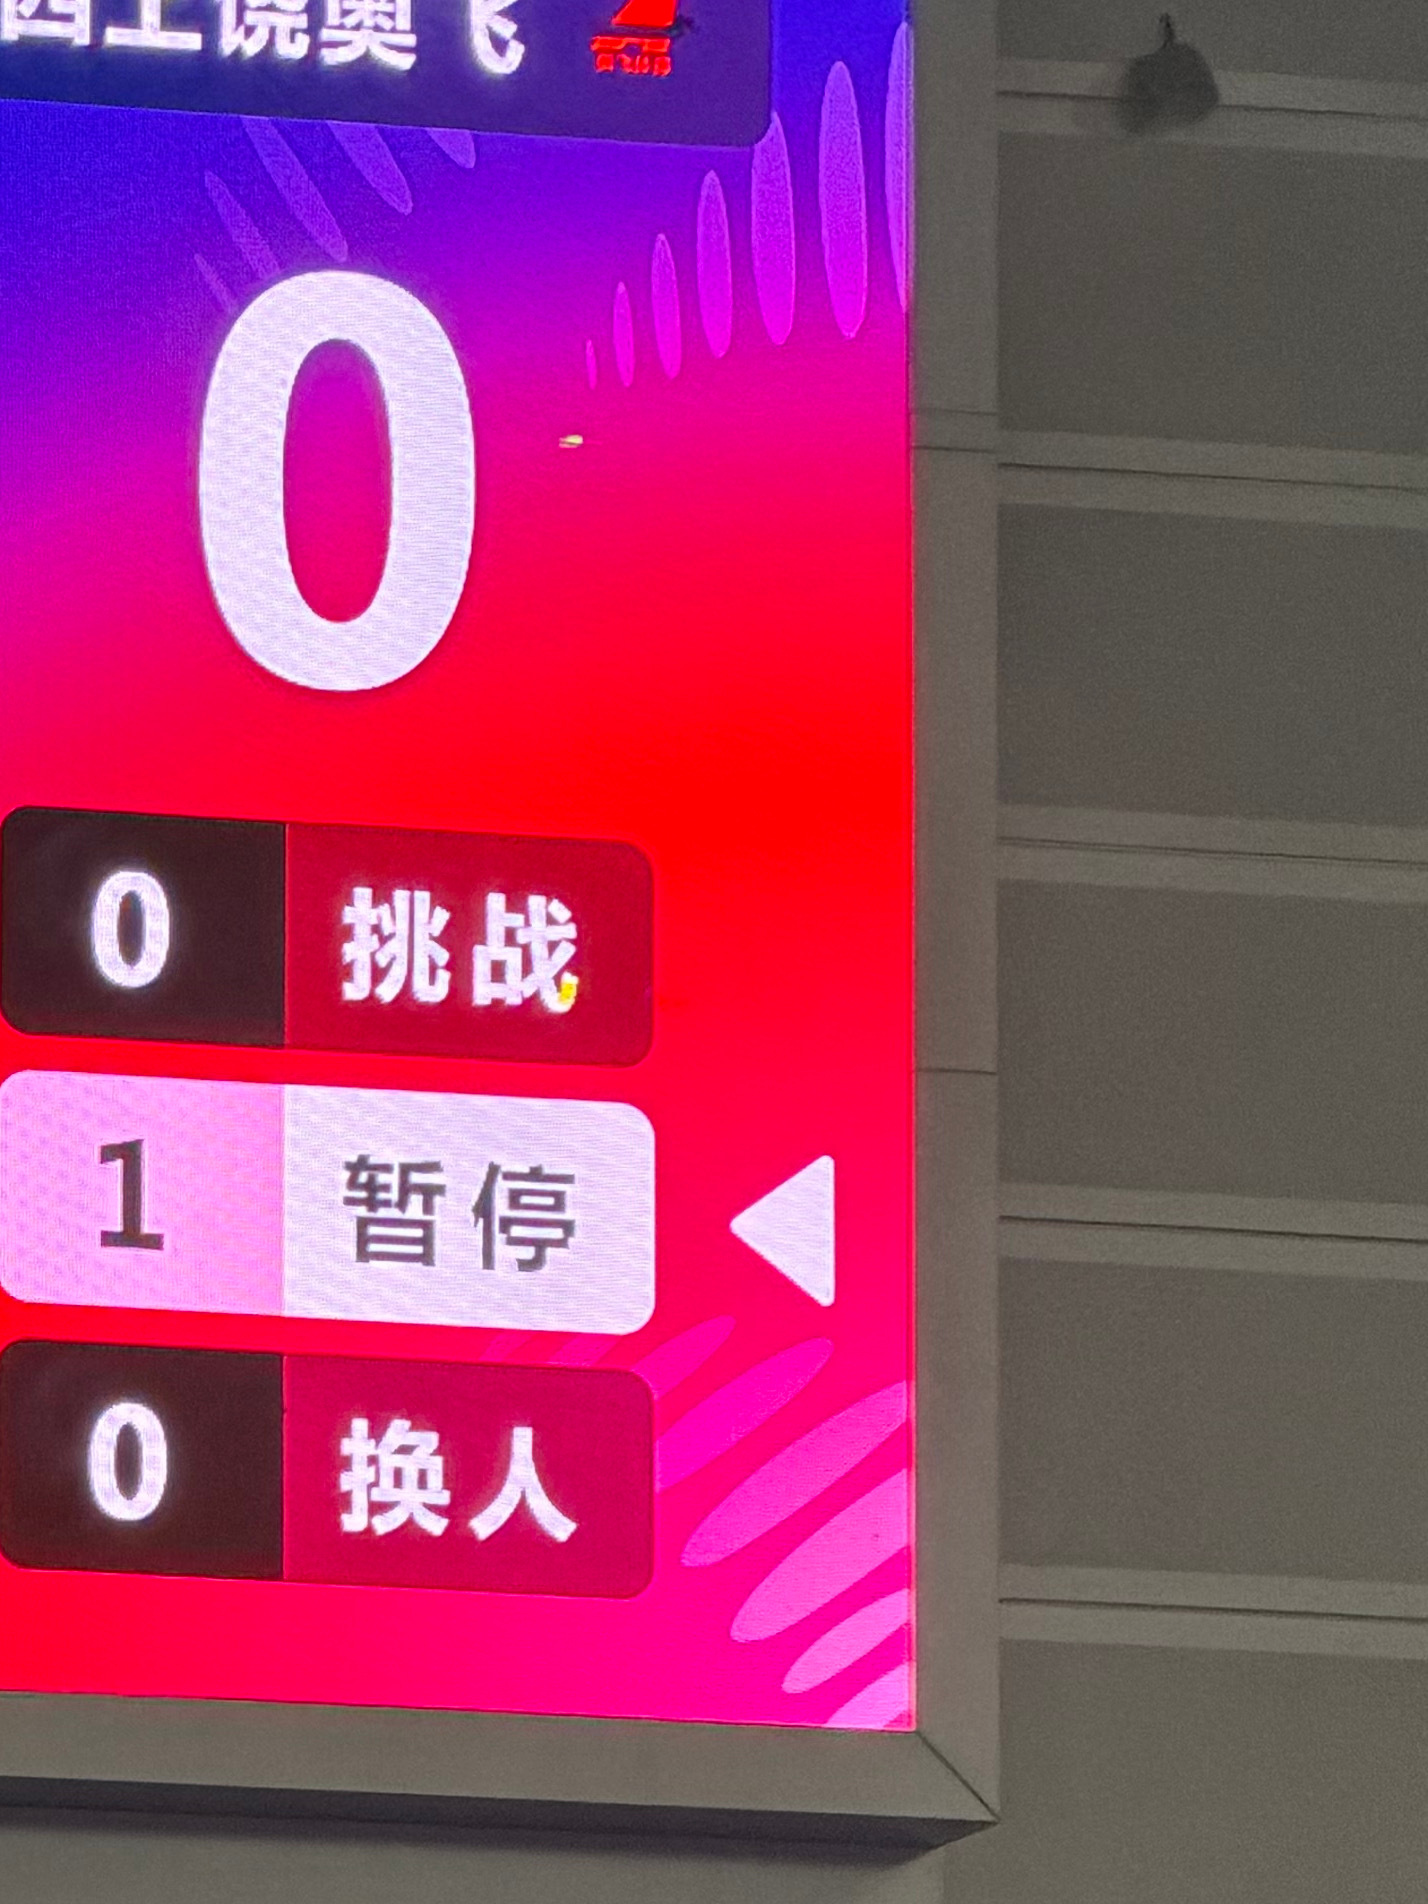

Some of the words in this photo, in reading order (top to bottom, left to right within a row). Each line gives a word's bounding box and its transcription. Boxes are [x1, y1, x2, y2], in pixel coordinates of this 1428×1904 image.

[198, 270, 476, 692] 0
[89, 868, 172, 990] 0
[342, 886, 580, 1014] 挑战
[99, 1138, 165, 1252] 1
[343, 1154, 576, 1273] 暂停
[86, 1400, 169, 1522] 0
[338, 1417, 578, 1543] 换人
